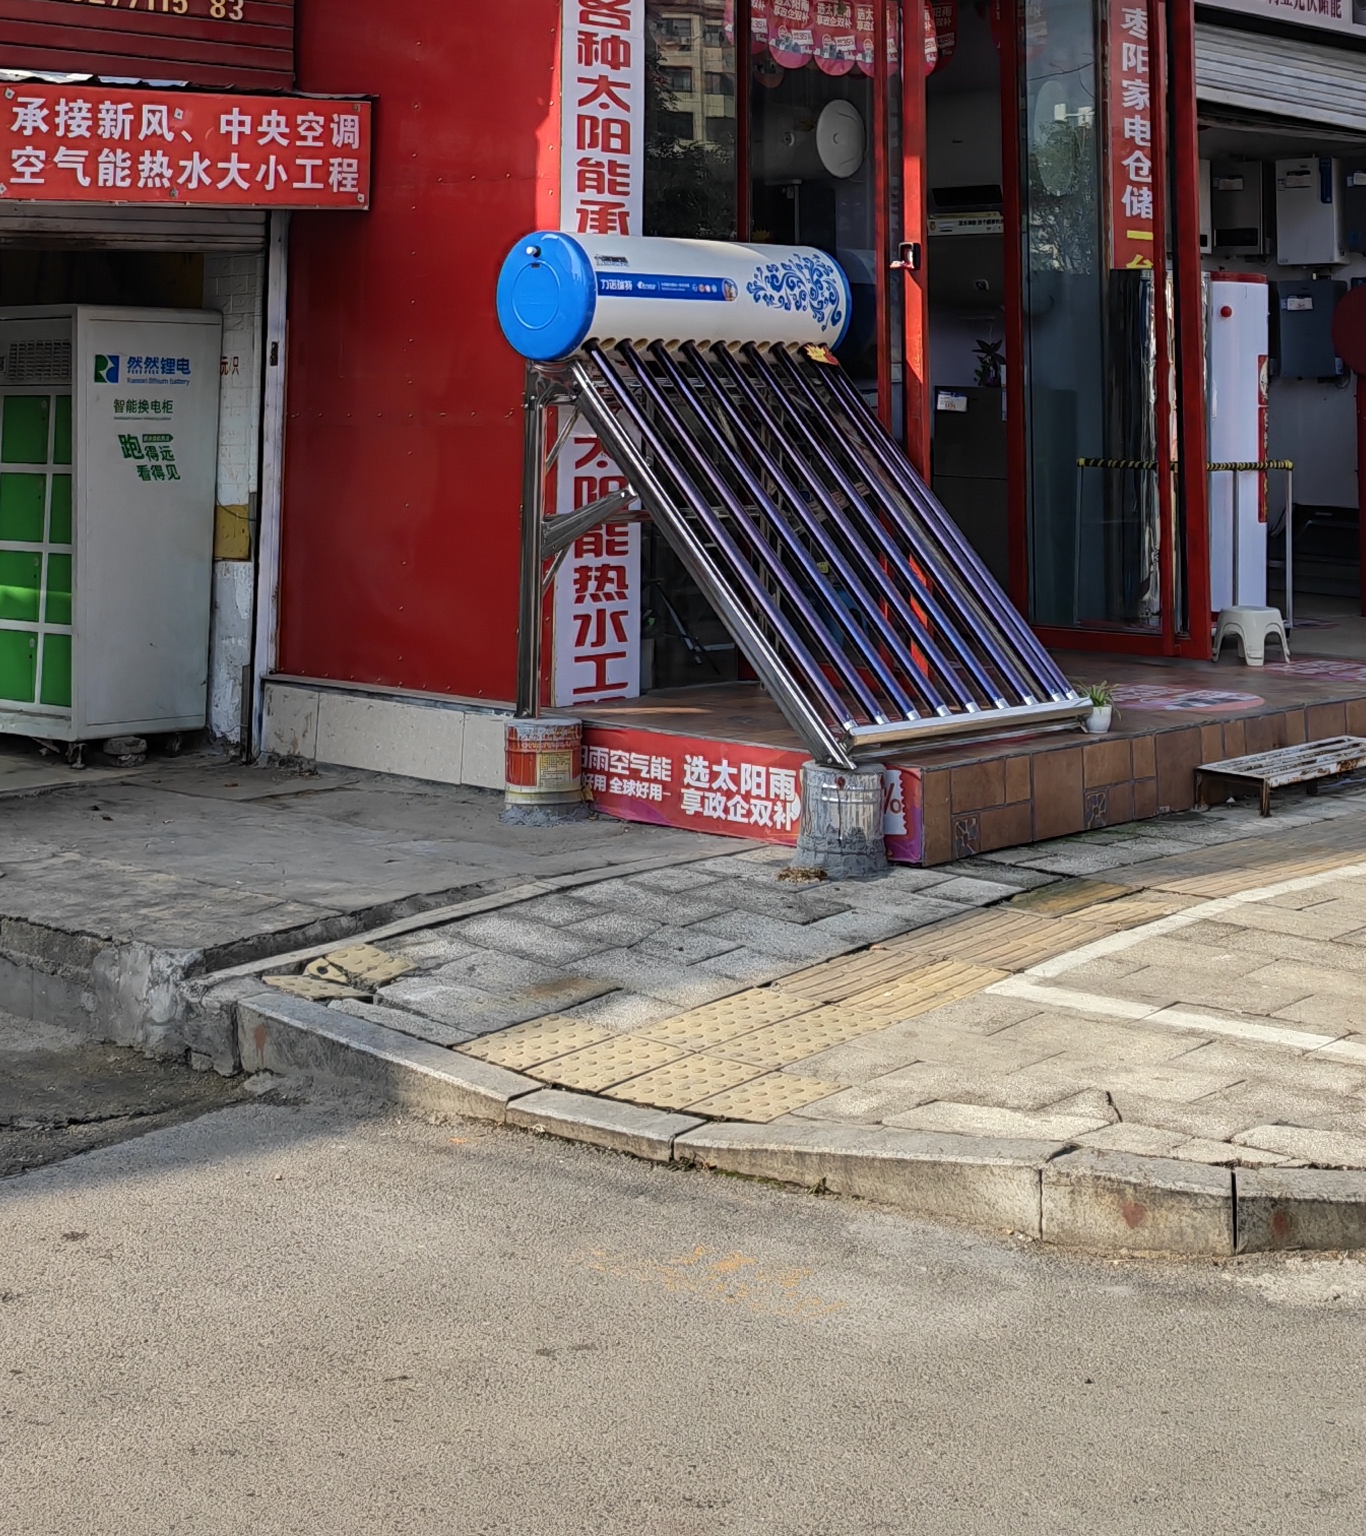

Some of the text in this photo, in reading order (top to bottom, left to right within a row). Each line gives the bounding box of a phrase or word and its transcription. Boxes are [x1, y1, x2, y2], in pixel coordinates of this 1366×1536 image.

[11, 96, 361, 150] 承接新风、中央空调
[10, 146, 360, 194] 空气能热水大小工程
[127, 356, 191, 375] 然然锂电
[114, 399, 173, 414] 智能换电柜
[136, 464, 180, 481] 看得见
[573, 437, 629, 706] 太阳能热水工
[684, 754, 797, 800] 选太阳雨
[681, 788, 795, 831] 享政企双补
